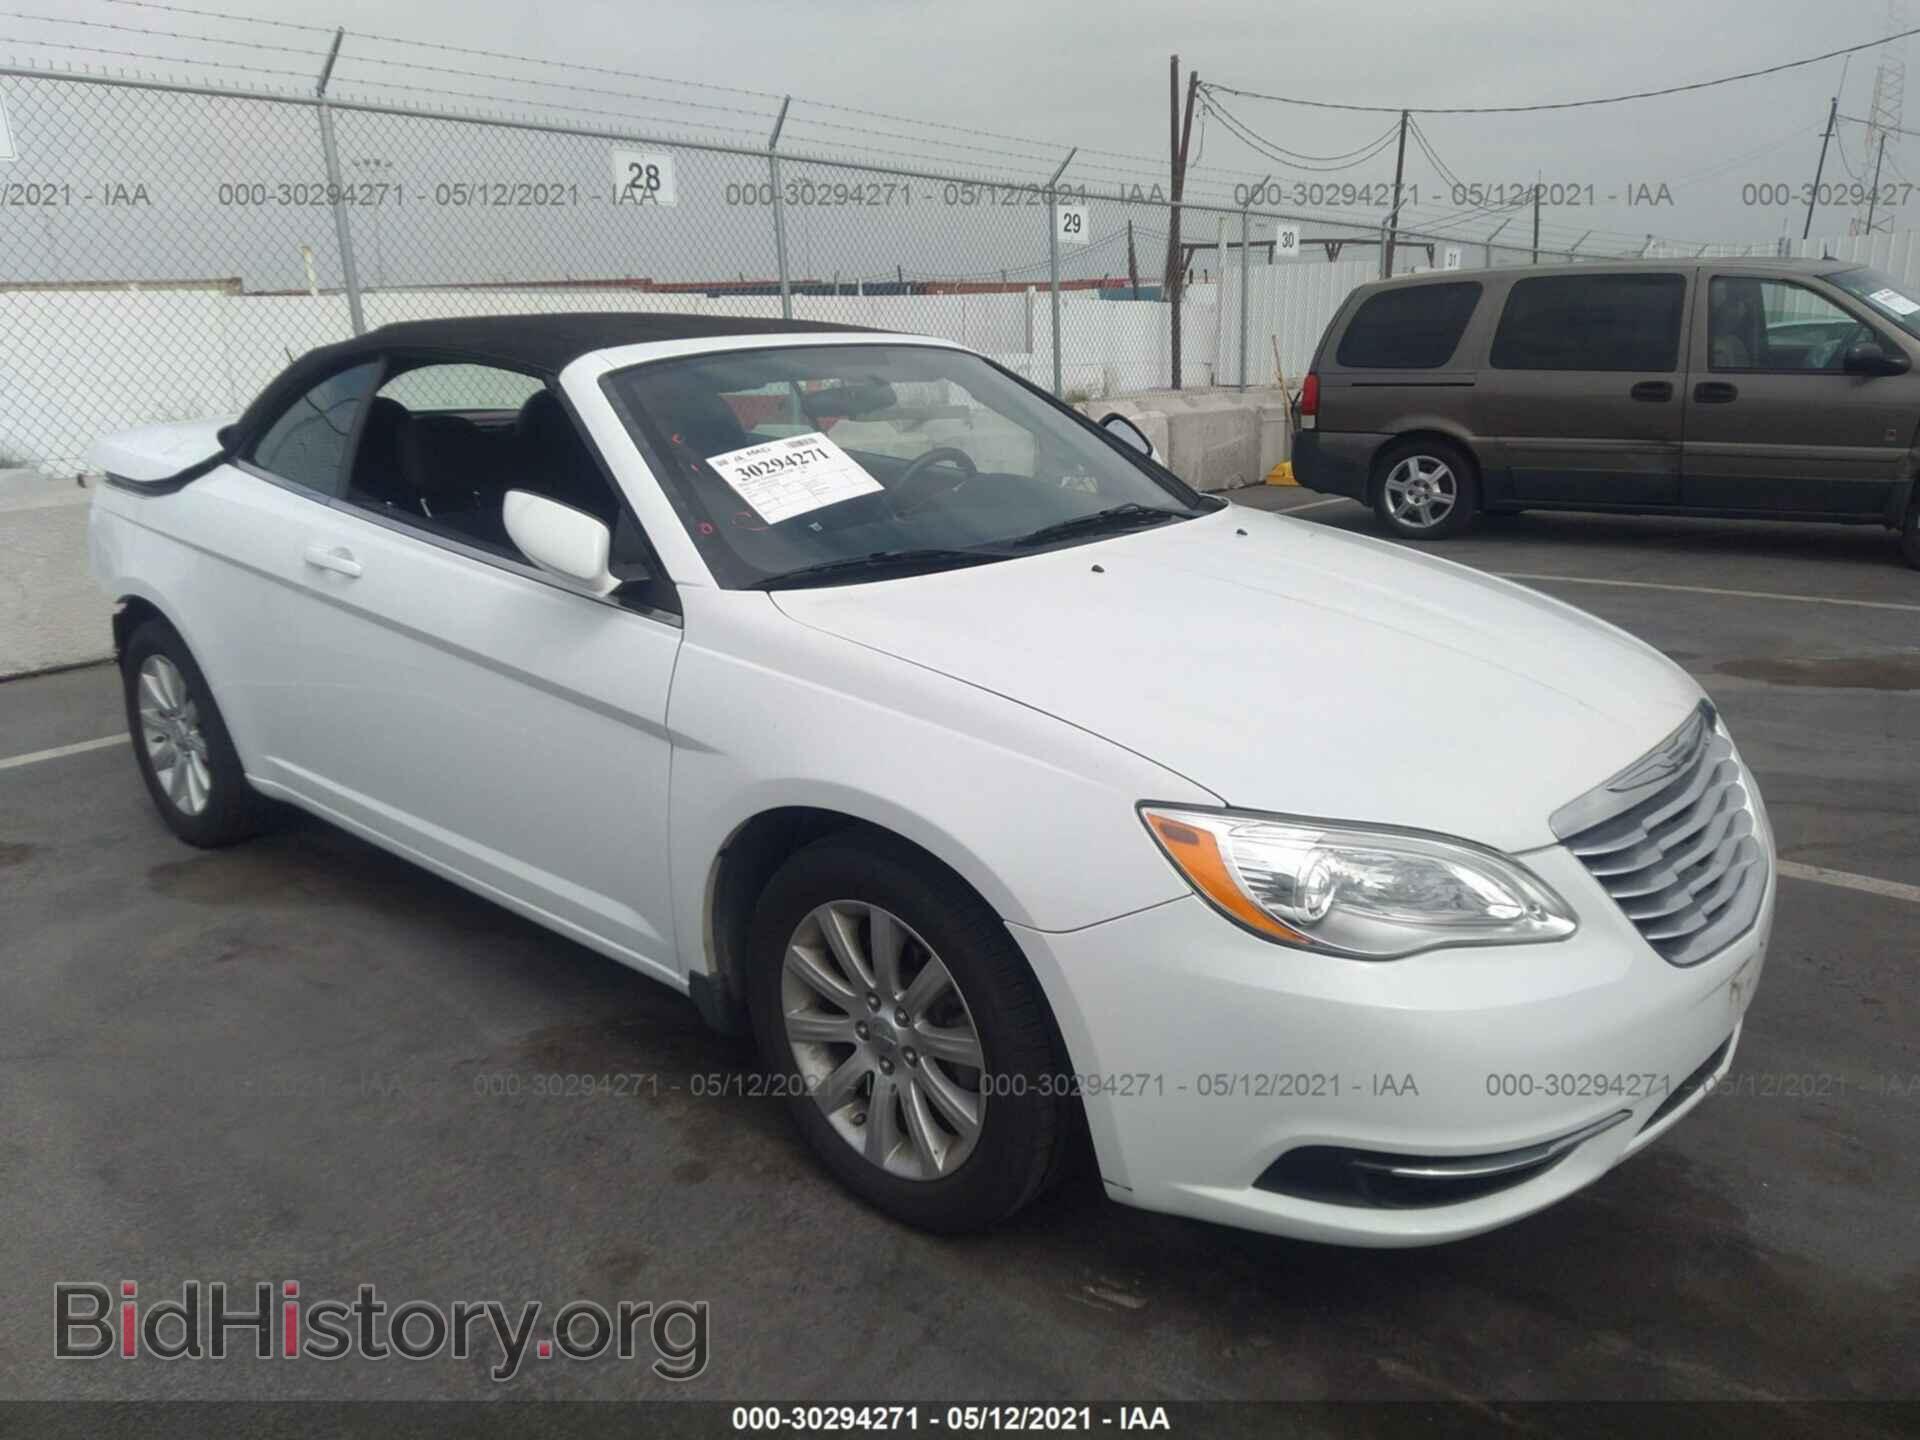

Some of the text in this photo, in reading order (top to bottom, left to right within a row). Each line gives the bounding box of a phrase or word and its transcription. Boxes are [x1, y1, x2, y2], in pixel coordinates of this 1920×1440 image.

[629, 162, 660, 191] 28
[1063, 213, 1081, 233] 29
[1282, 231, 1295, 248] 30
[735, 447, 830, 481] 30294271
